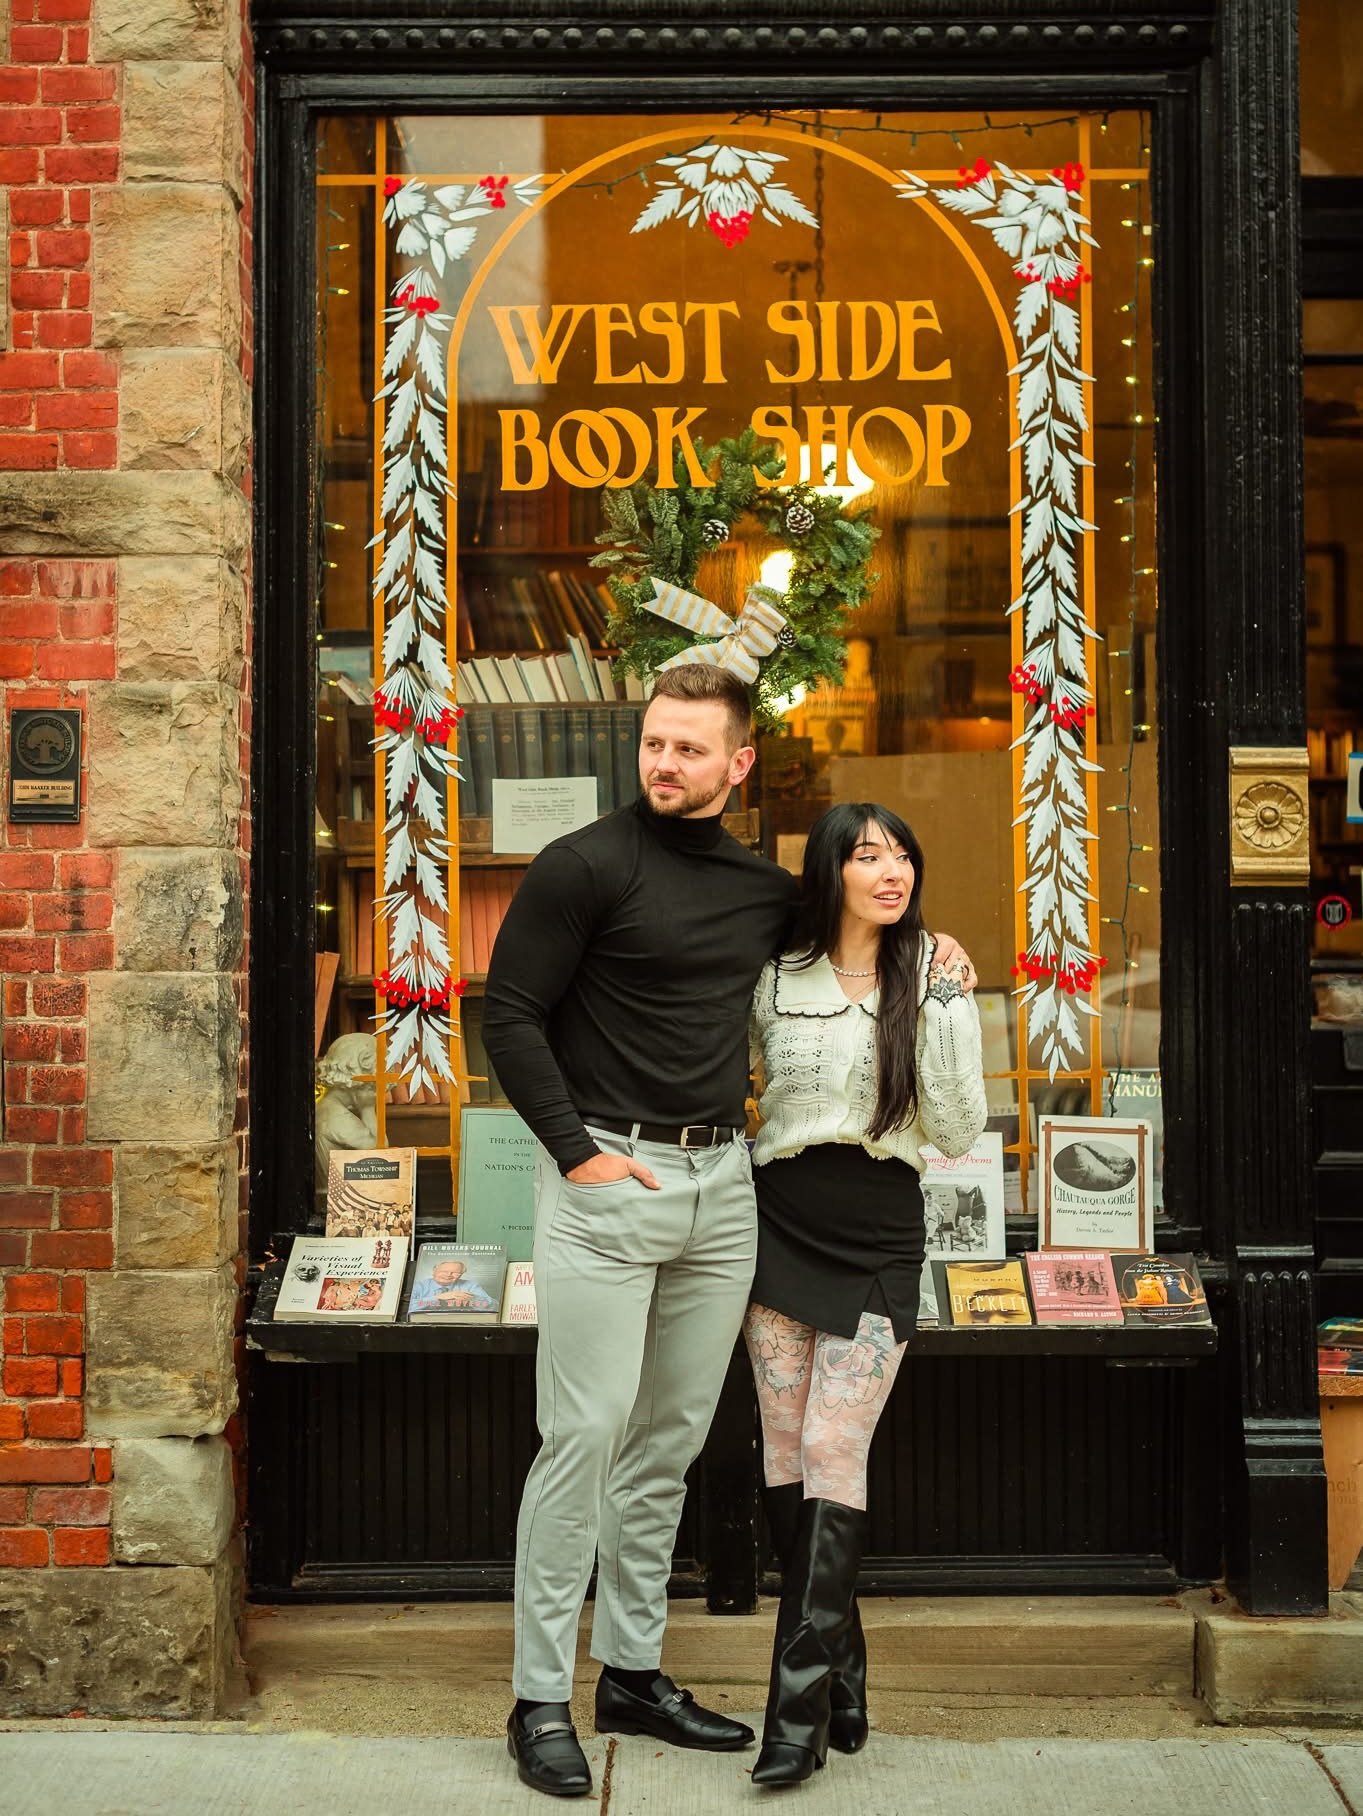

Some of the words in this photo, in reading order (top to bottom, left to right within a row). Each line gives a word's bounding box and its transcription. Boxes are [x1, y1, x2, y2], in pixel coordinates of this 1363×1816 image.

[488, 300, 740, 384] WEST
[765, 300, 951, 384] SIDE
[498, 406, 717, 491] BOOK
[751, 404, 971, 488] SHOP
[484, 1164, 524, 1172] NATION'S
[961, 1153, 992, 1166] Poems
[1054, 1184, 1106, 1206] CHAUTAUQUA
[1108, 1187, 1136, 1205] GORGE
[326, 1269, 388, 1277] Experience
[952, 1294, 1026, 1313] BECKETT
